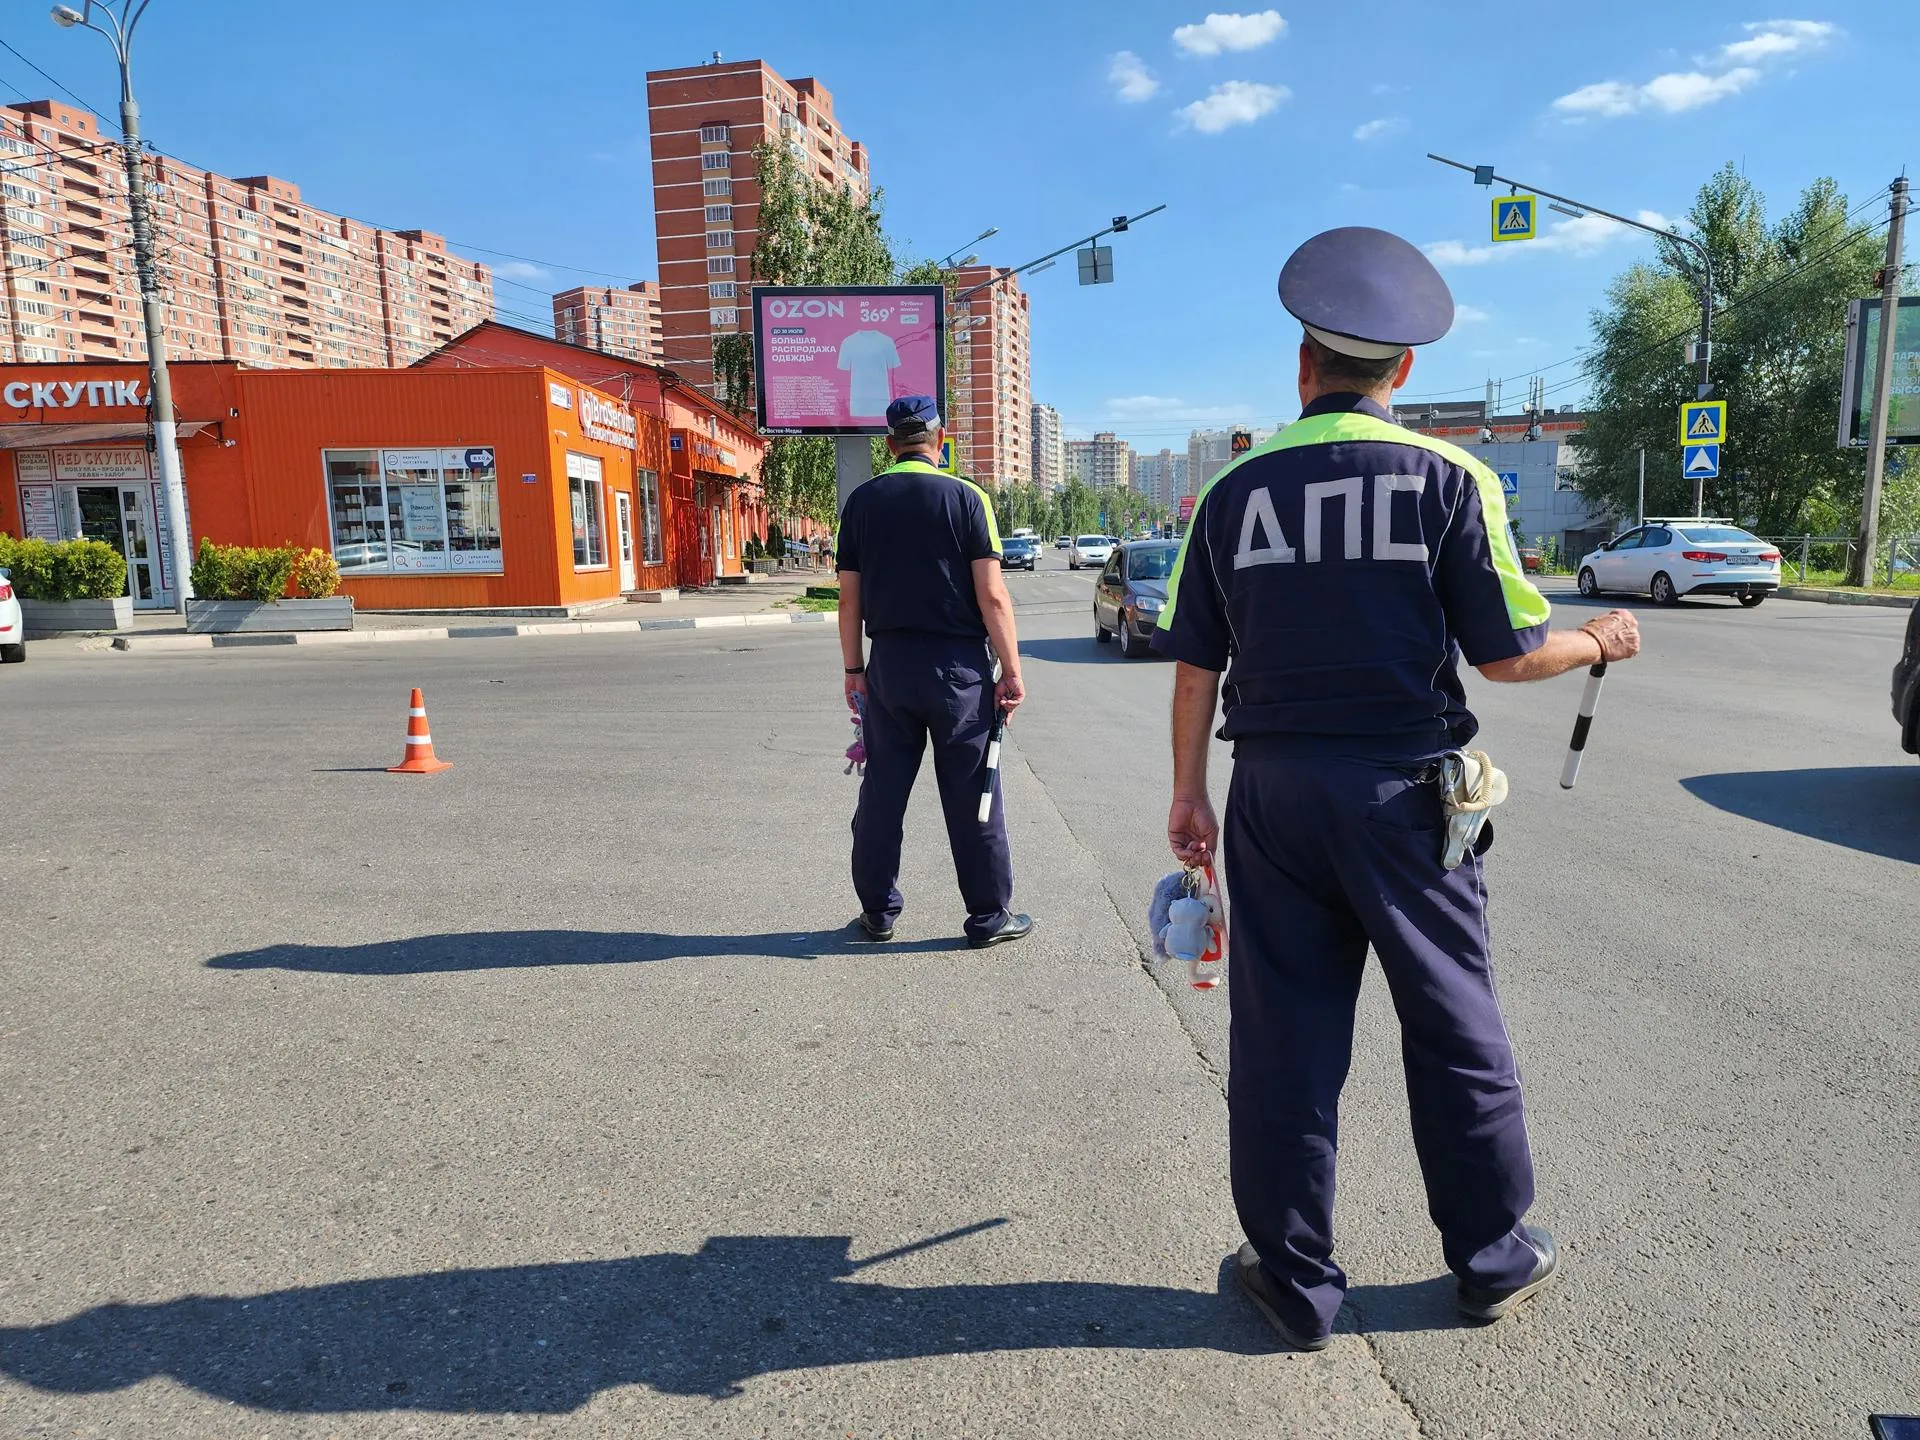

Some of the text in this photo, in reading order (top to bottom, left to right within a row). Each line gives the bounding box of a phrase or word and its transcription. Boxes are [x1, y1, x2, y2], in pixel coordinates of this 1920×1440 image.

[770, 300, 844, 318] OZON
[771, 346, 837, 354] РАСПРОДАЖА
[771, 354, 814, 362] ОДЕЖДЫ
[3, 380, 151, 408] СКУПК
[57, 451, 143, 465] RED СКУПКА
[1233, 474, 1430, 570] ДПС
